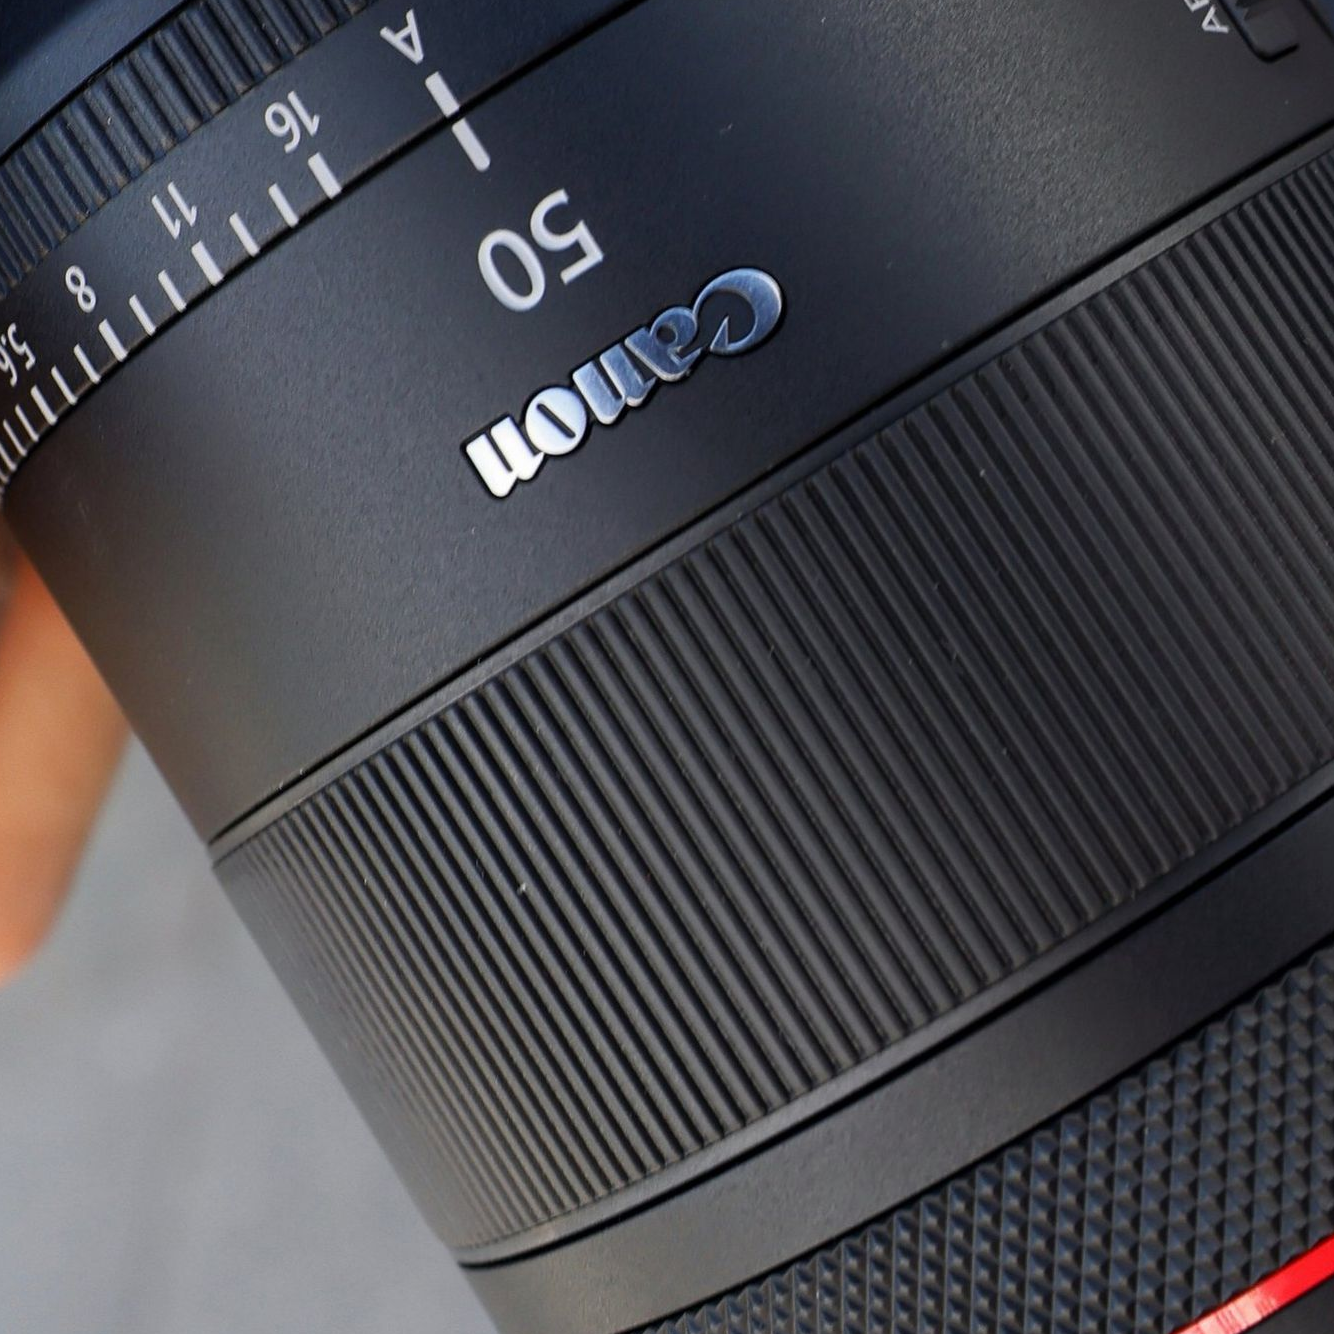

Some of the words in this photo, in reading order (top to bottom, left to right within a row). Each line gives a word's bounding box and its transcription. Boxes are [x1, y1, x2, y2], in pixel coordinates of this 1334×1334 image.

[380, 9, 424, 64] A
[265, 91, 320, 153] 16
[152, 182, 197, 240] 11
[478, 188, 604, 312] 50
[65, 265, 96, 313] 8
[466, 267, 783, 498] Canon
